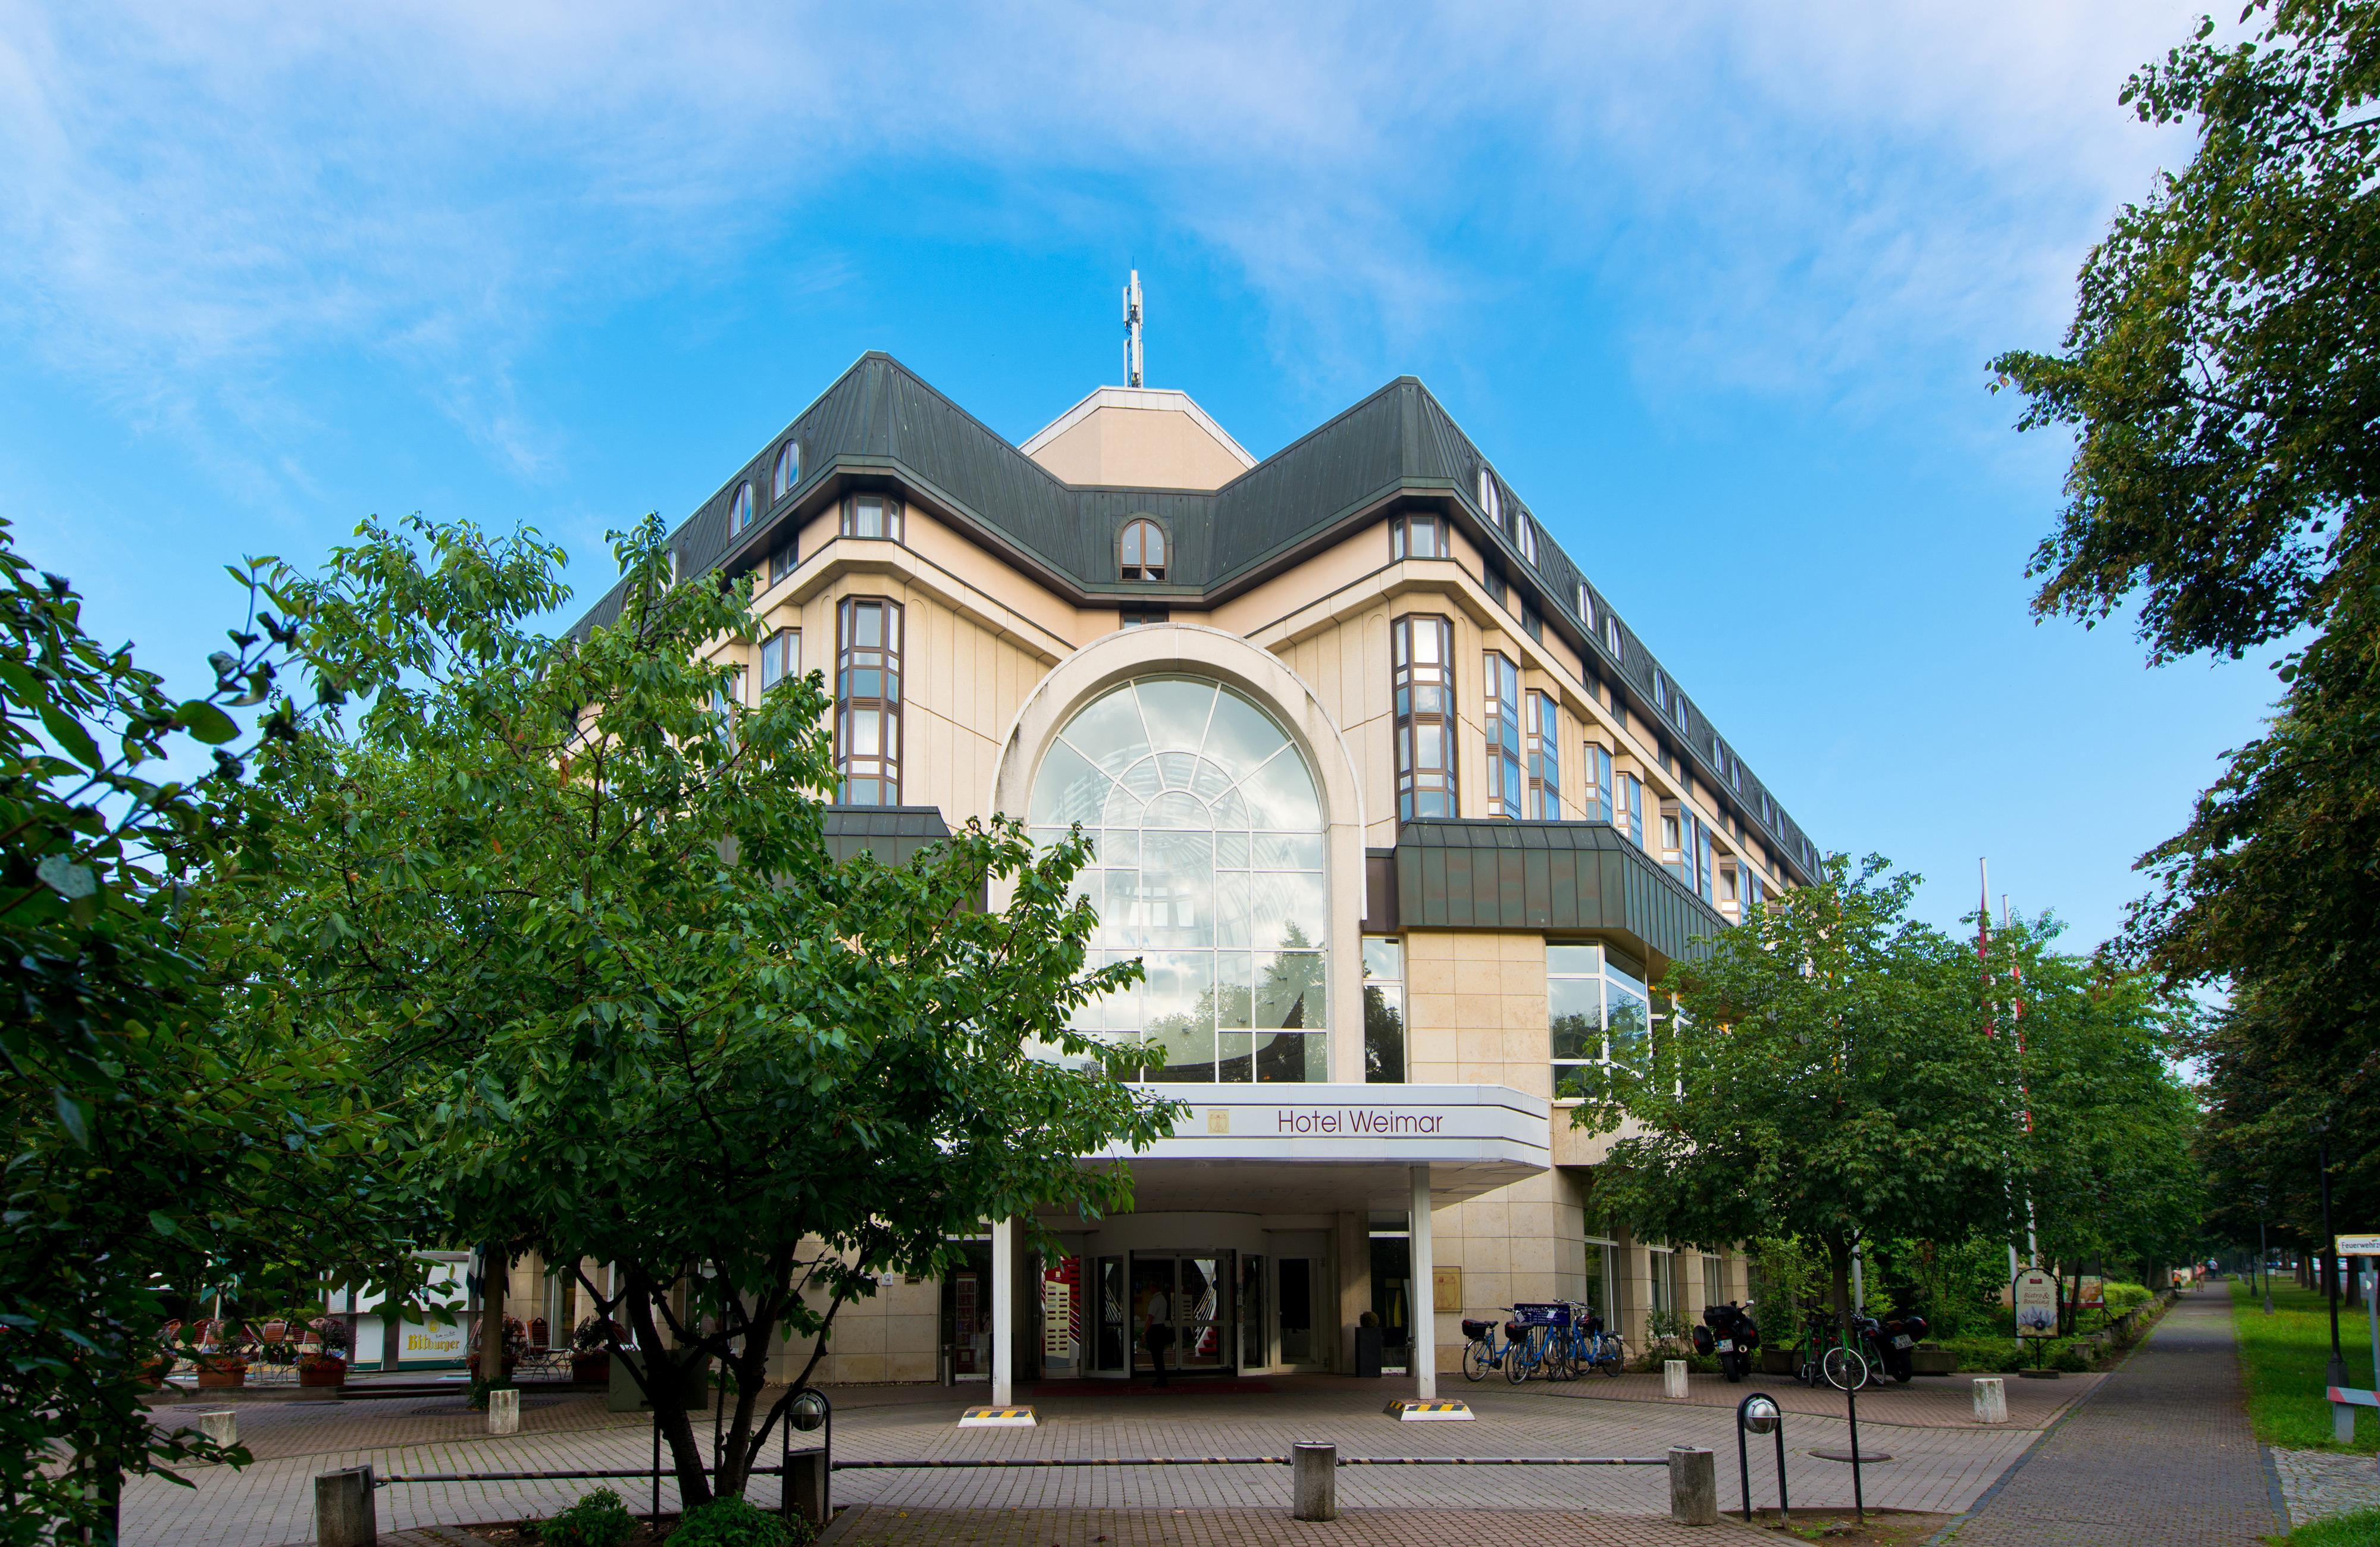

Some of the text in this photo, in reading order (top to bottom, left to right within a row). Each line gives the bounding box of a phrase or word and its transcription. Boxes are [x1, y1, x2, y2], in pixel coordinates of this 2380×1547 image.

[1279, 1110, 1443, 1133] Hotel Weimar
[2023, 1298, 2050, 1308] Bowling
[407, 1334, 460, 1352] Bitburger
